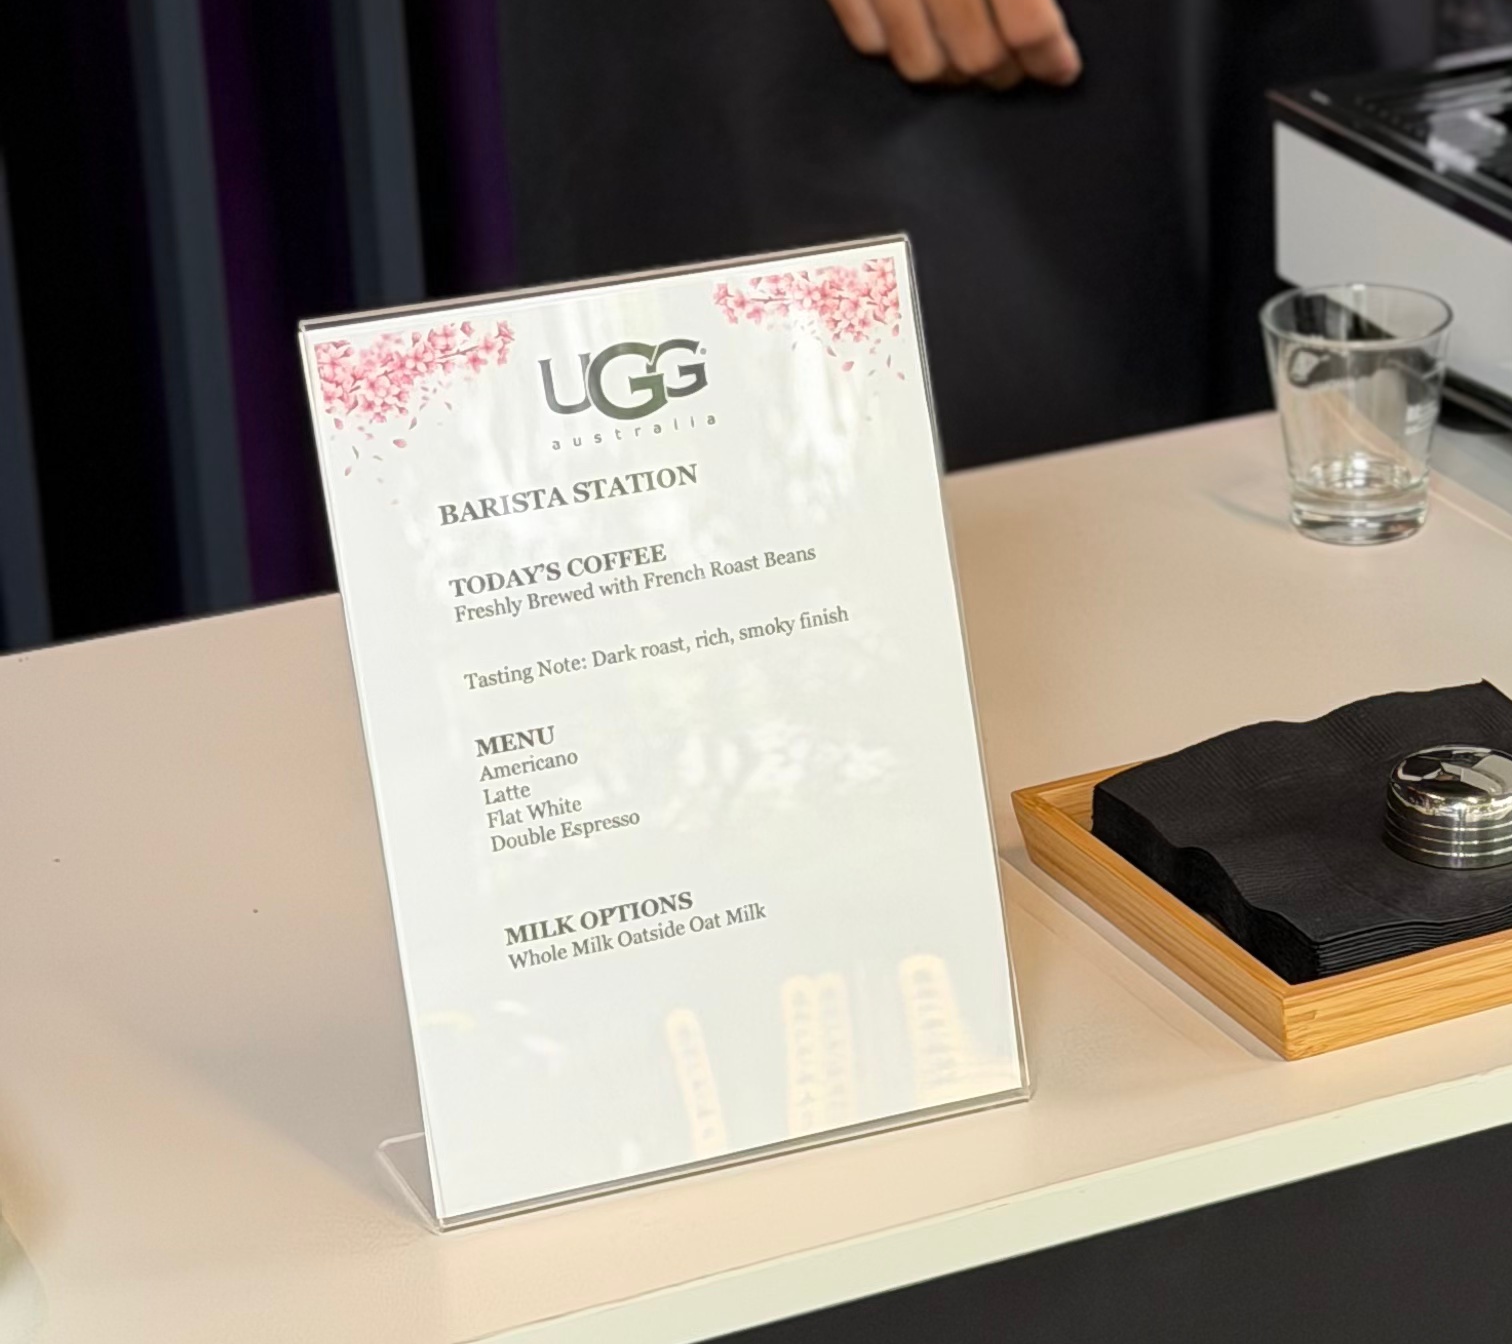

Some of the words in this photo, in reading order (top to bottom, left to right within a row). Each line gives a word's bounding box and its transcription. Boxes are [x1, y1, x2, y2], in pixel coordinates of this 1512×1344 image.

[538, 338, 708, 420] UGG
[552, 415, 716, 450] australia
[438, 487, 569, 526] BARISTA
[572, 463, 698, 503] STATION
[449, 561, 561, 597] TODAY'S
[567, 543, 667, 577] COFFEE
[454, 596, 523, 623] Freshly
[527, 581, 595, 610] Brewed
[599, 575, 639, 597] with
[644, 564, 706, 590] French
[709, 555, 760, 578] Roast
[764, 547, 816, 568] Beans
[464, 665, 534, 690] Tasting
[537, 657, 588, 677] Note:
[592, 644, 637, 668] Dark
[641, 636, 691, 659] roast,
[695, 627, 735, 649] rich,
[739, 616, 795, 641] smoky
[800, 605, 849, 630] finish
[474, 725, 555, 757] MENU
[479, 751, 578, 782] Americano
[483, 784, 531, 805] Latte
[486, 808, 523, 829] Flat
[526, 797, 582, 821] White
[491, 825, 556, 852] Double
[561, 811, 640, 838] Espresso
[504, 915, 576, 946] MILK
[580, 891, 693, 930] OPTIONS
[508, 944, 568, 969] Whole
[571, 934, 614, 958] Milk
[617, 920, 686, 947] Oatside
[689, 913, 722, 934] Oat
[726, 902, 767, 926] Milk
